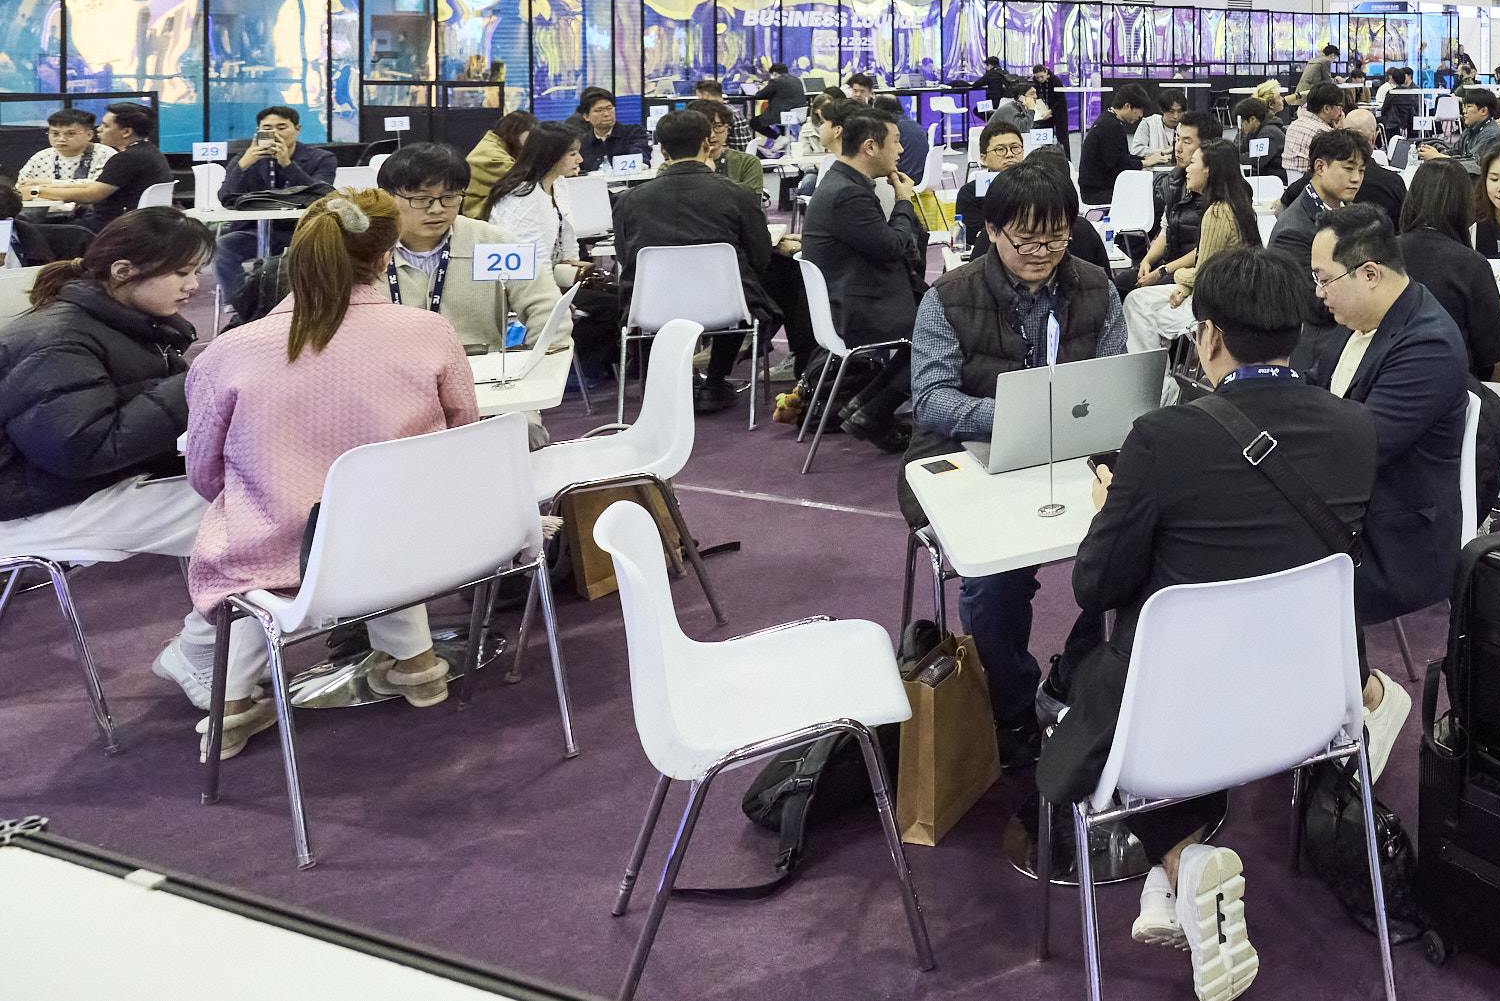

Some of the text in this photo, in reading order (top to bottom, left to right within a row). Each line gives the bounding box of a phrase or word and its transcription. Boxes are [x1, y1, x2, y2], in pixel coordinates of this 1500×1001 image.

[742, 9, 848, 28] BUSINESS
[1036, 133, 1048, 141] 23
[201, 147, 219, 157] 29
[1255, 143, 1265, 152] 18
[621, 160, 636, 171] 24
[487, 253, 521, 271] 20
